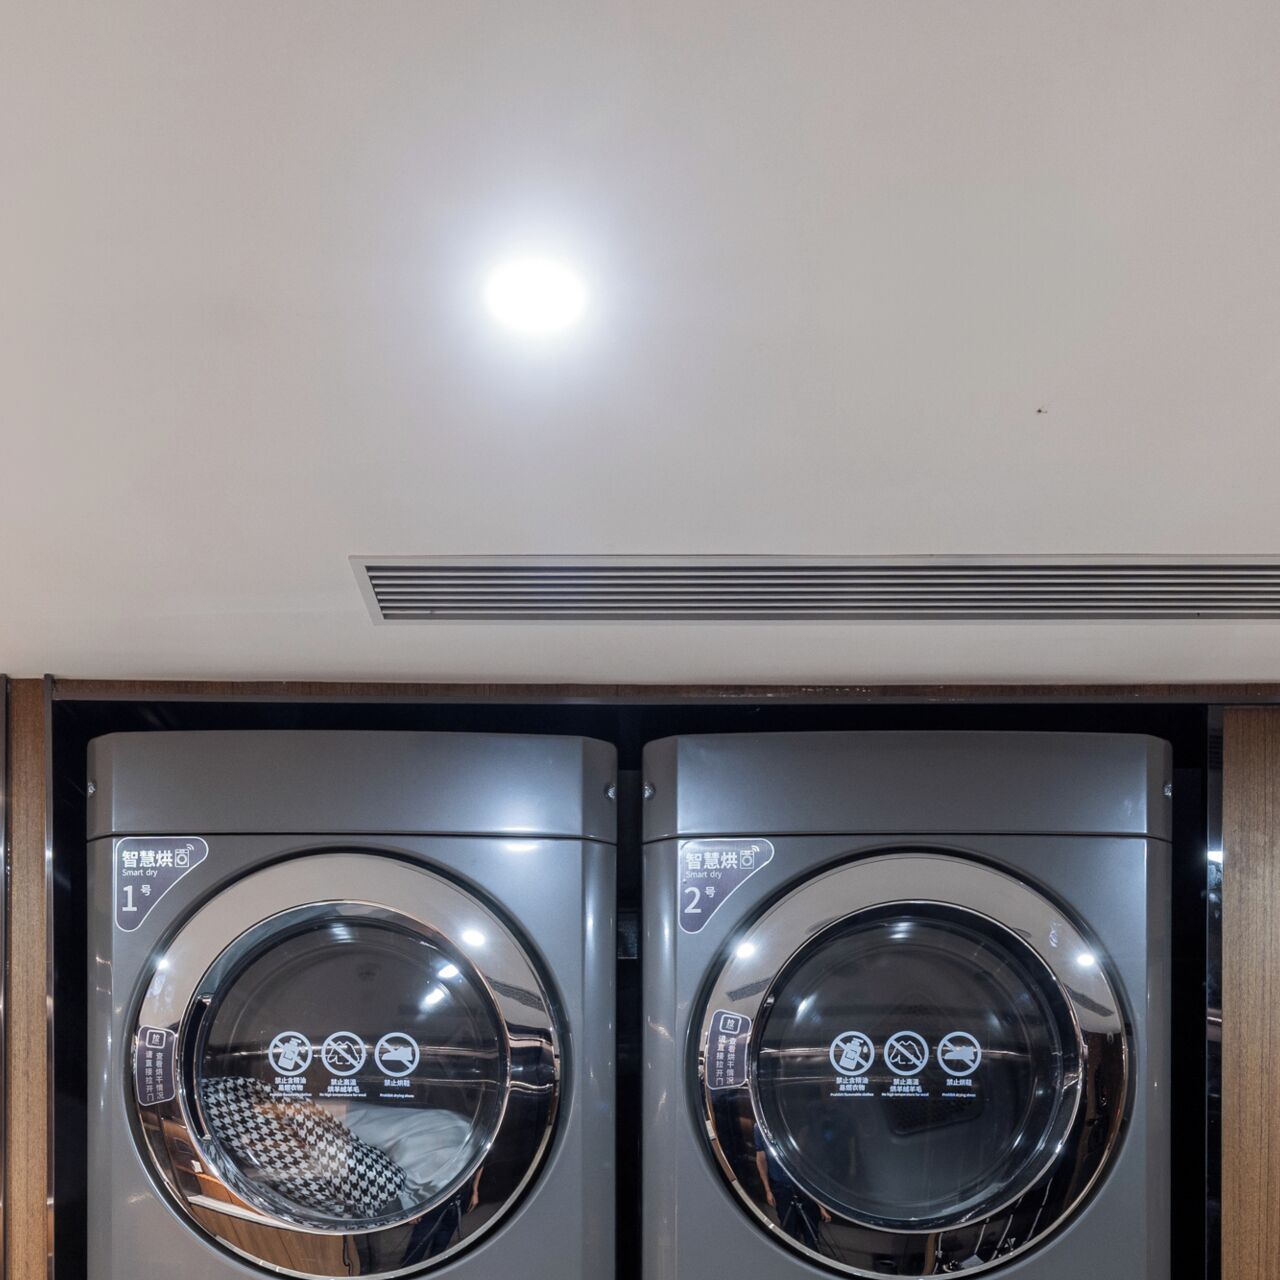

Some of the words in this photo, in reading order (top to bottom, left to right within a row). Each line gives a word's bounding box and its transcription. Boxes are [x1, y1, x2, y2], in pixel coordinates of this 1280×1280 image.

[122, 850, 173, 868] 智慧烘
[686, 852, 738, 869] 智慧烘
[122, 869, 143, 877] Smart
[146, 869, 158, 877] dry
[710, 870, 722, 879] dry
[331, 1078, 356, 1086] 禁止高温
[893, 1078, 919, 1086] 禁止高温
